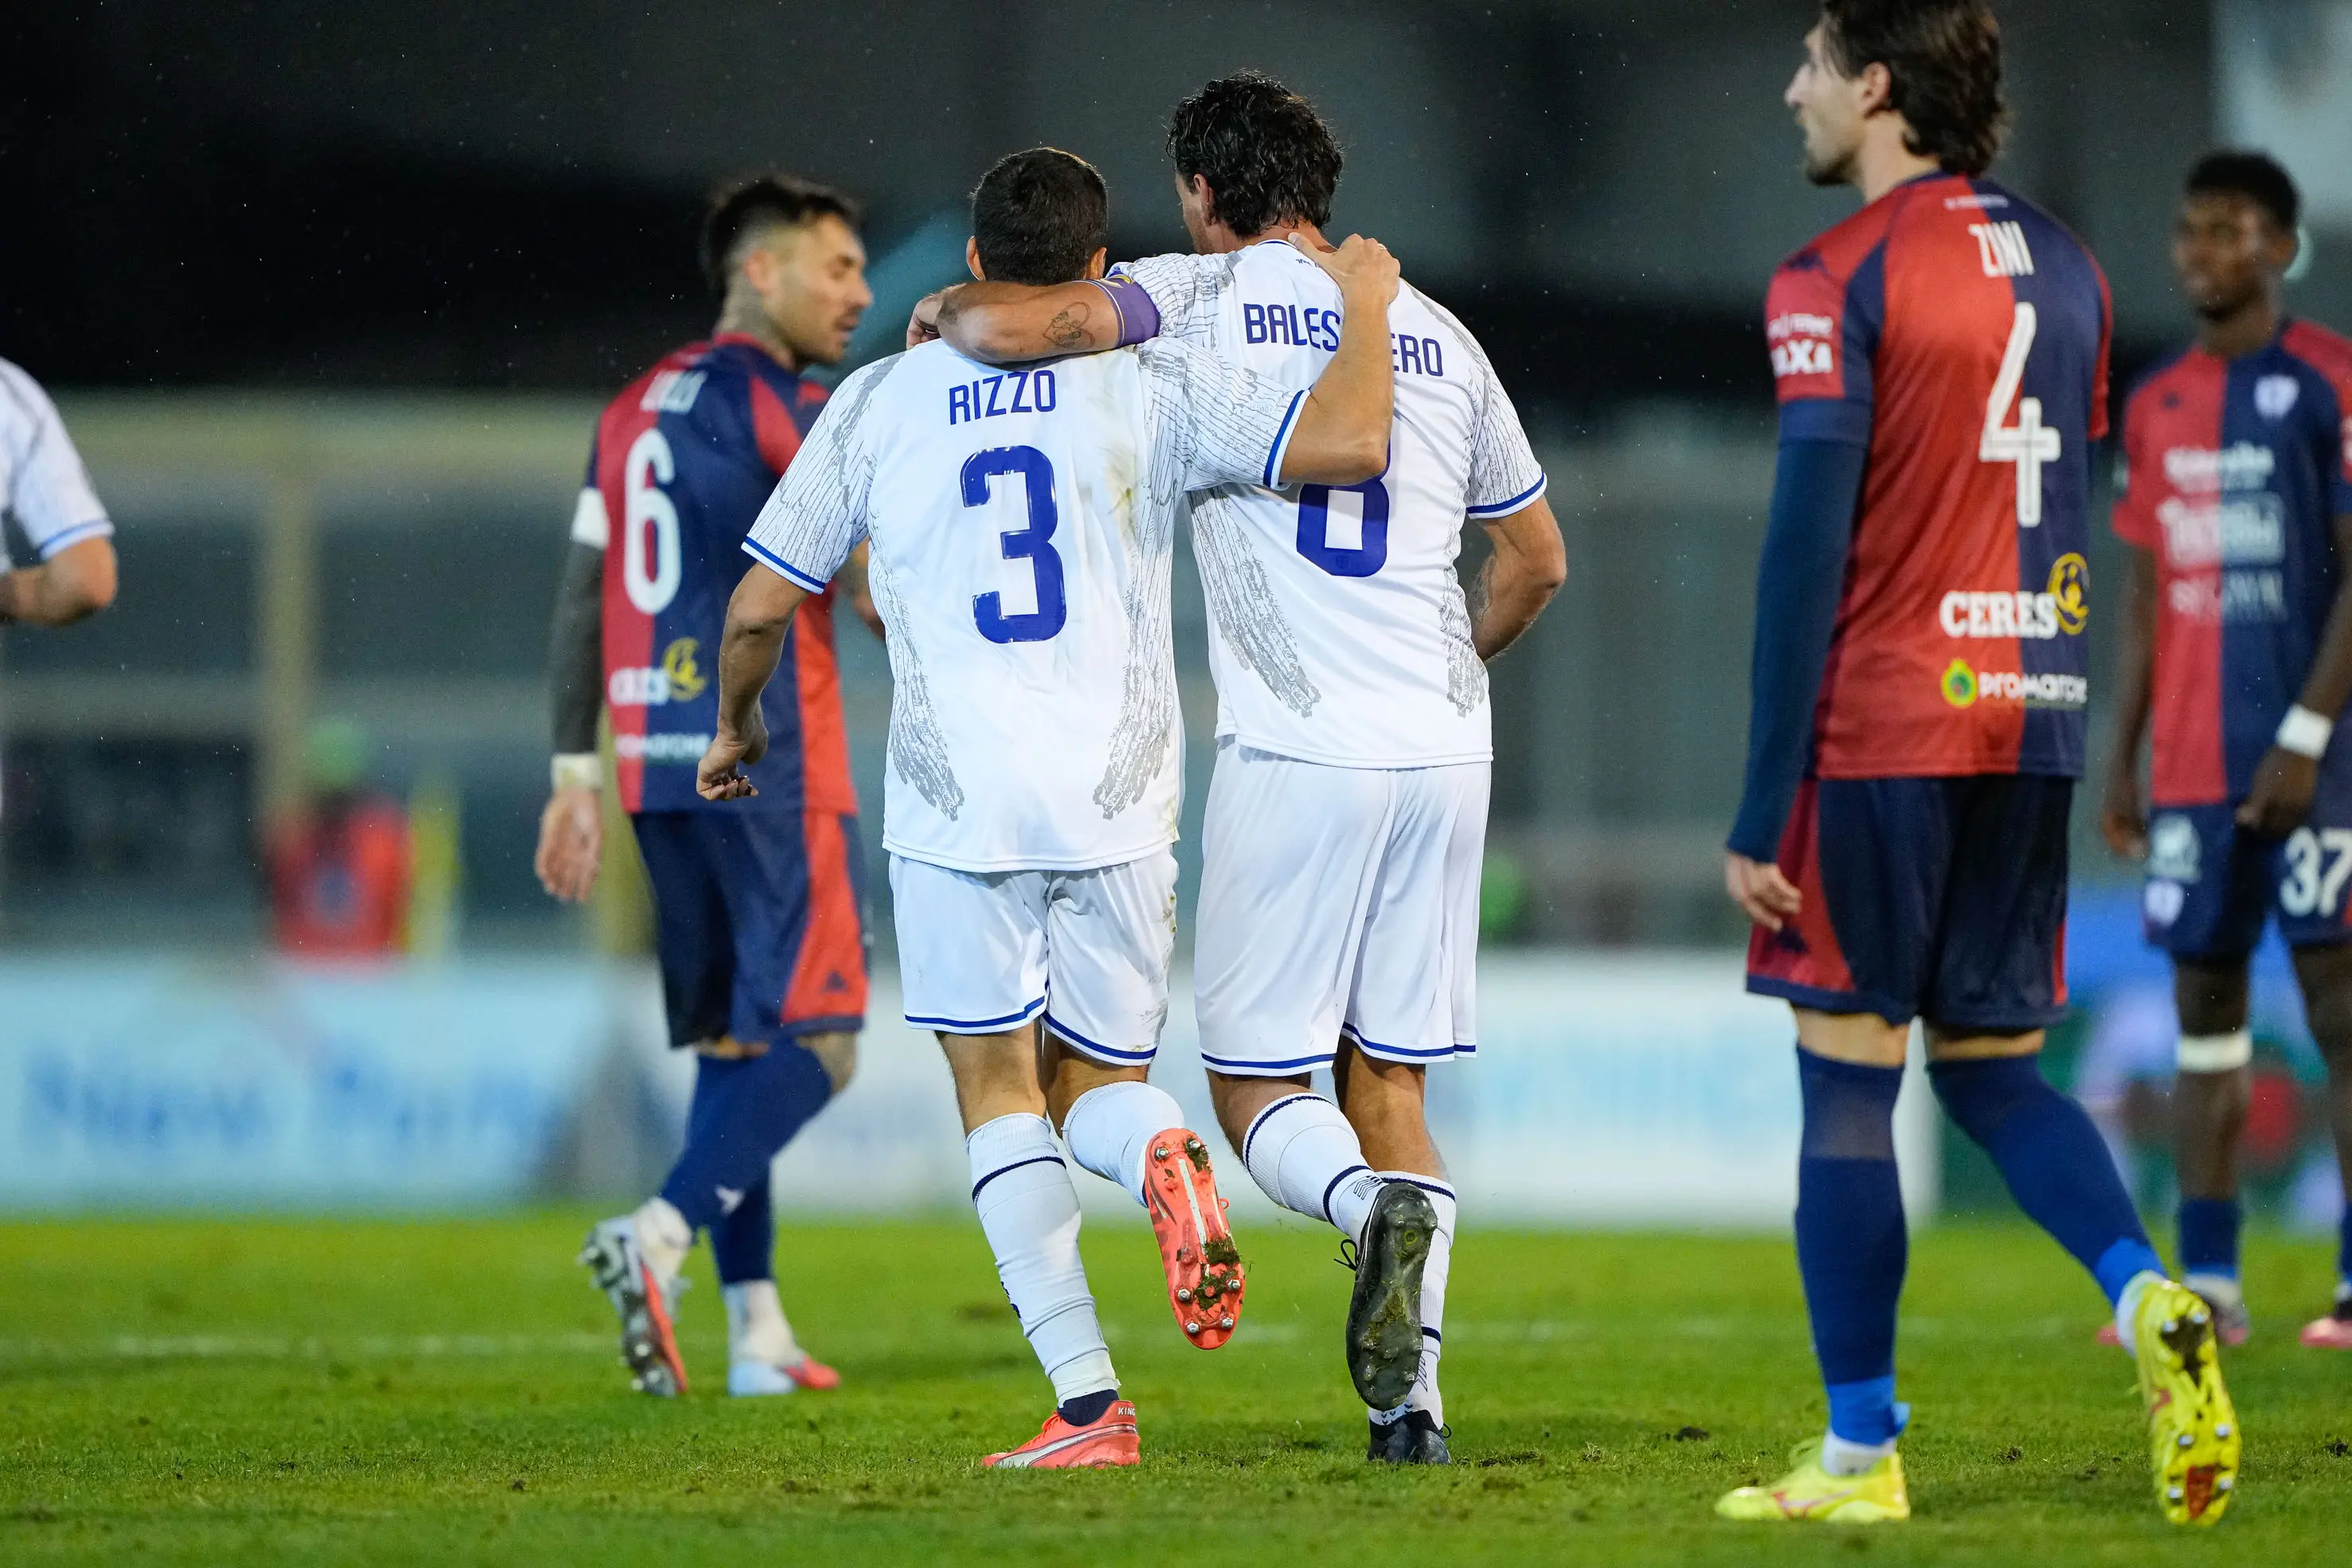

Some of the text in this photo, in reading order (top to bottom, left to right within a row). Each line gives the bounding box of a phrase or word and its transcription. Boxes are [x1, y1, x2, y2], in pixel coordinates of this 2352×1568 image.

[1967, 220, 2035, 278] ZINI
[1243, 303, 1444, 377] BALESRO
[949, 370, 1056, 425] RIZZO
[1978, 302, 2061, 528] 4
[624, 427, 683, 615] 6
[959, 444, 1067, 644] 3
[1939, 591, 2059, 640] CERES
[2280, 825, 2352, 918] 37
[1117, 1406, 1137, 1416] KING
